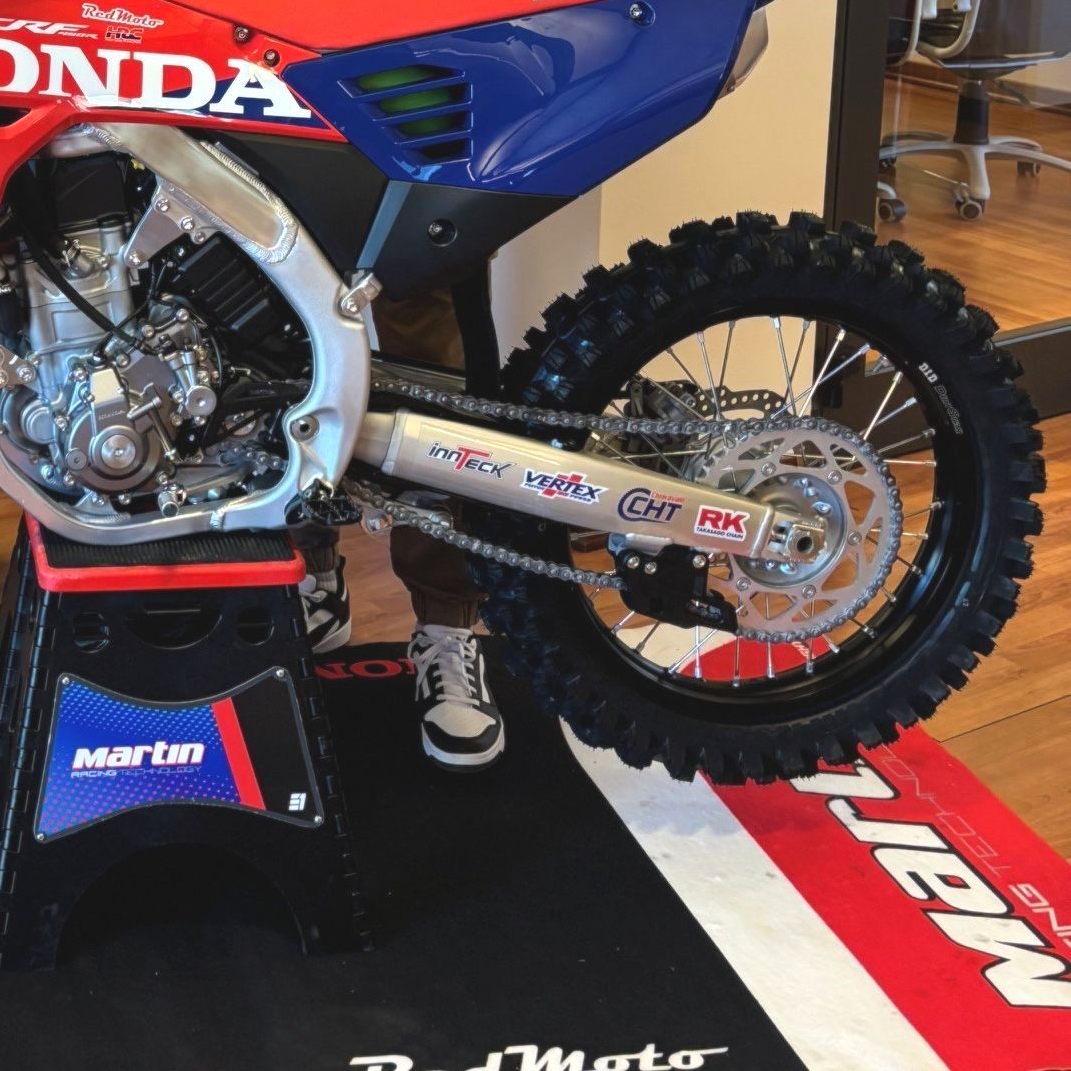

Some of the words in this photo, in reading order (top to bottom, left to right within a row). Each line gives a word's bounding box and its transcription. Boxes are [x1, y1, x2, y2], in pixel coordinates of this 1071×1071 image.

[83, 3, 163, 27] RedMoto
[105, 26, 143, 41] HRC
[527, 470, 603, 499] VERTEX
[625, 494, 683, 522] CHT
[698, 508, 747, 533] RK
[696, 526, 726, 536] TAKASAGO
[726, 531, 743, 540] CHAIN
[72, 740, 205, 769] Martin
[71, 769, 117, 778] RACING
[120, 766, 202, 776] TECHNOLOGY
